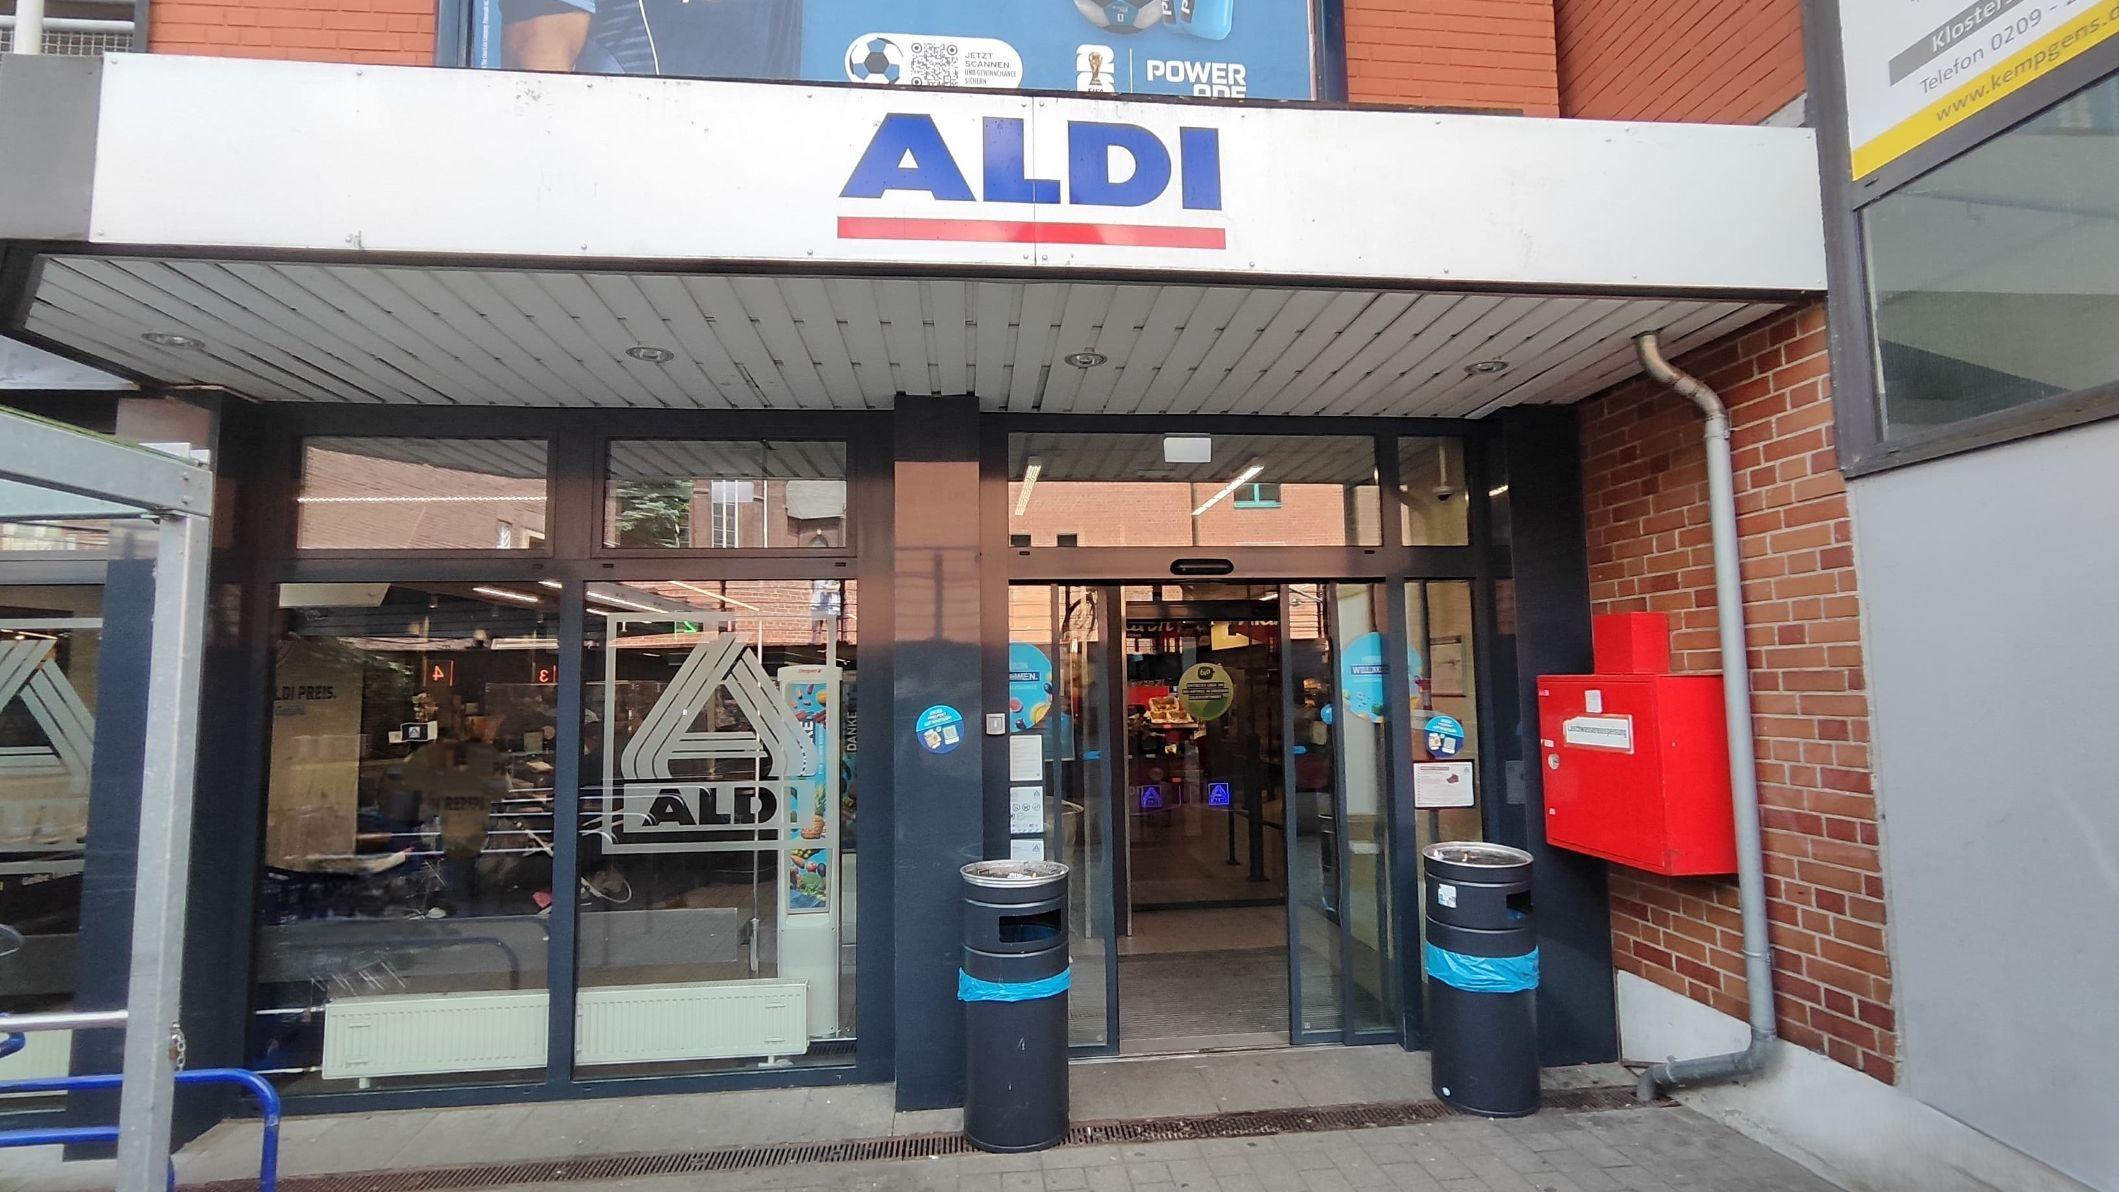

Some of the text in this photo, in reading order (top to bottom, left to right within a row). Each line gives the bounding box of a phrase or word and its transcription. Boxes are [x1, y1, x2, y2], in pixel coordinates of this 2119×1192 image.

[964, 60, 1010, 69] SCANNEN
[1919, 48, 1985, 95] Telefon
[1991, 8, 2042, 52] 0209
[1146, 59, 1247, 86] POWER
[839, 112, 1222, 211] ALDI
[846, 711, 857, 751] DANKE
[641, 786, 798, 827] ALDI
